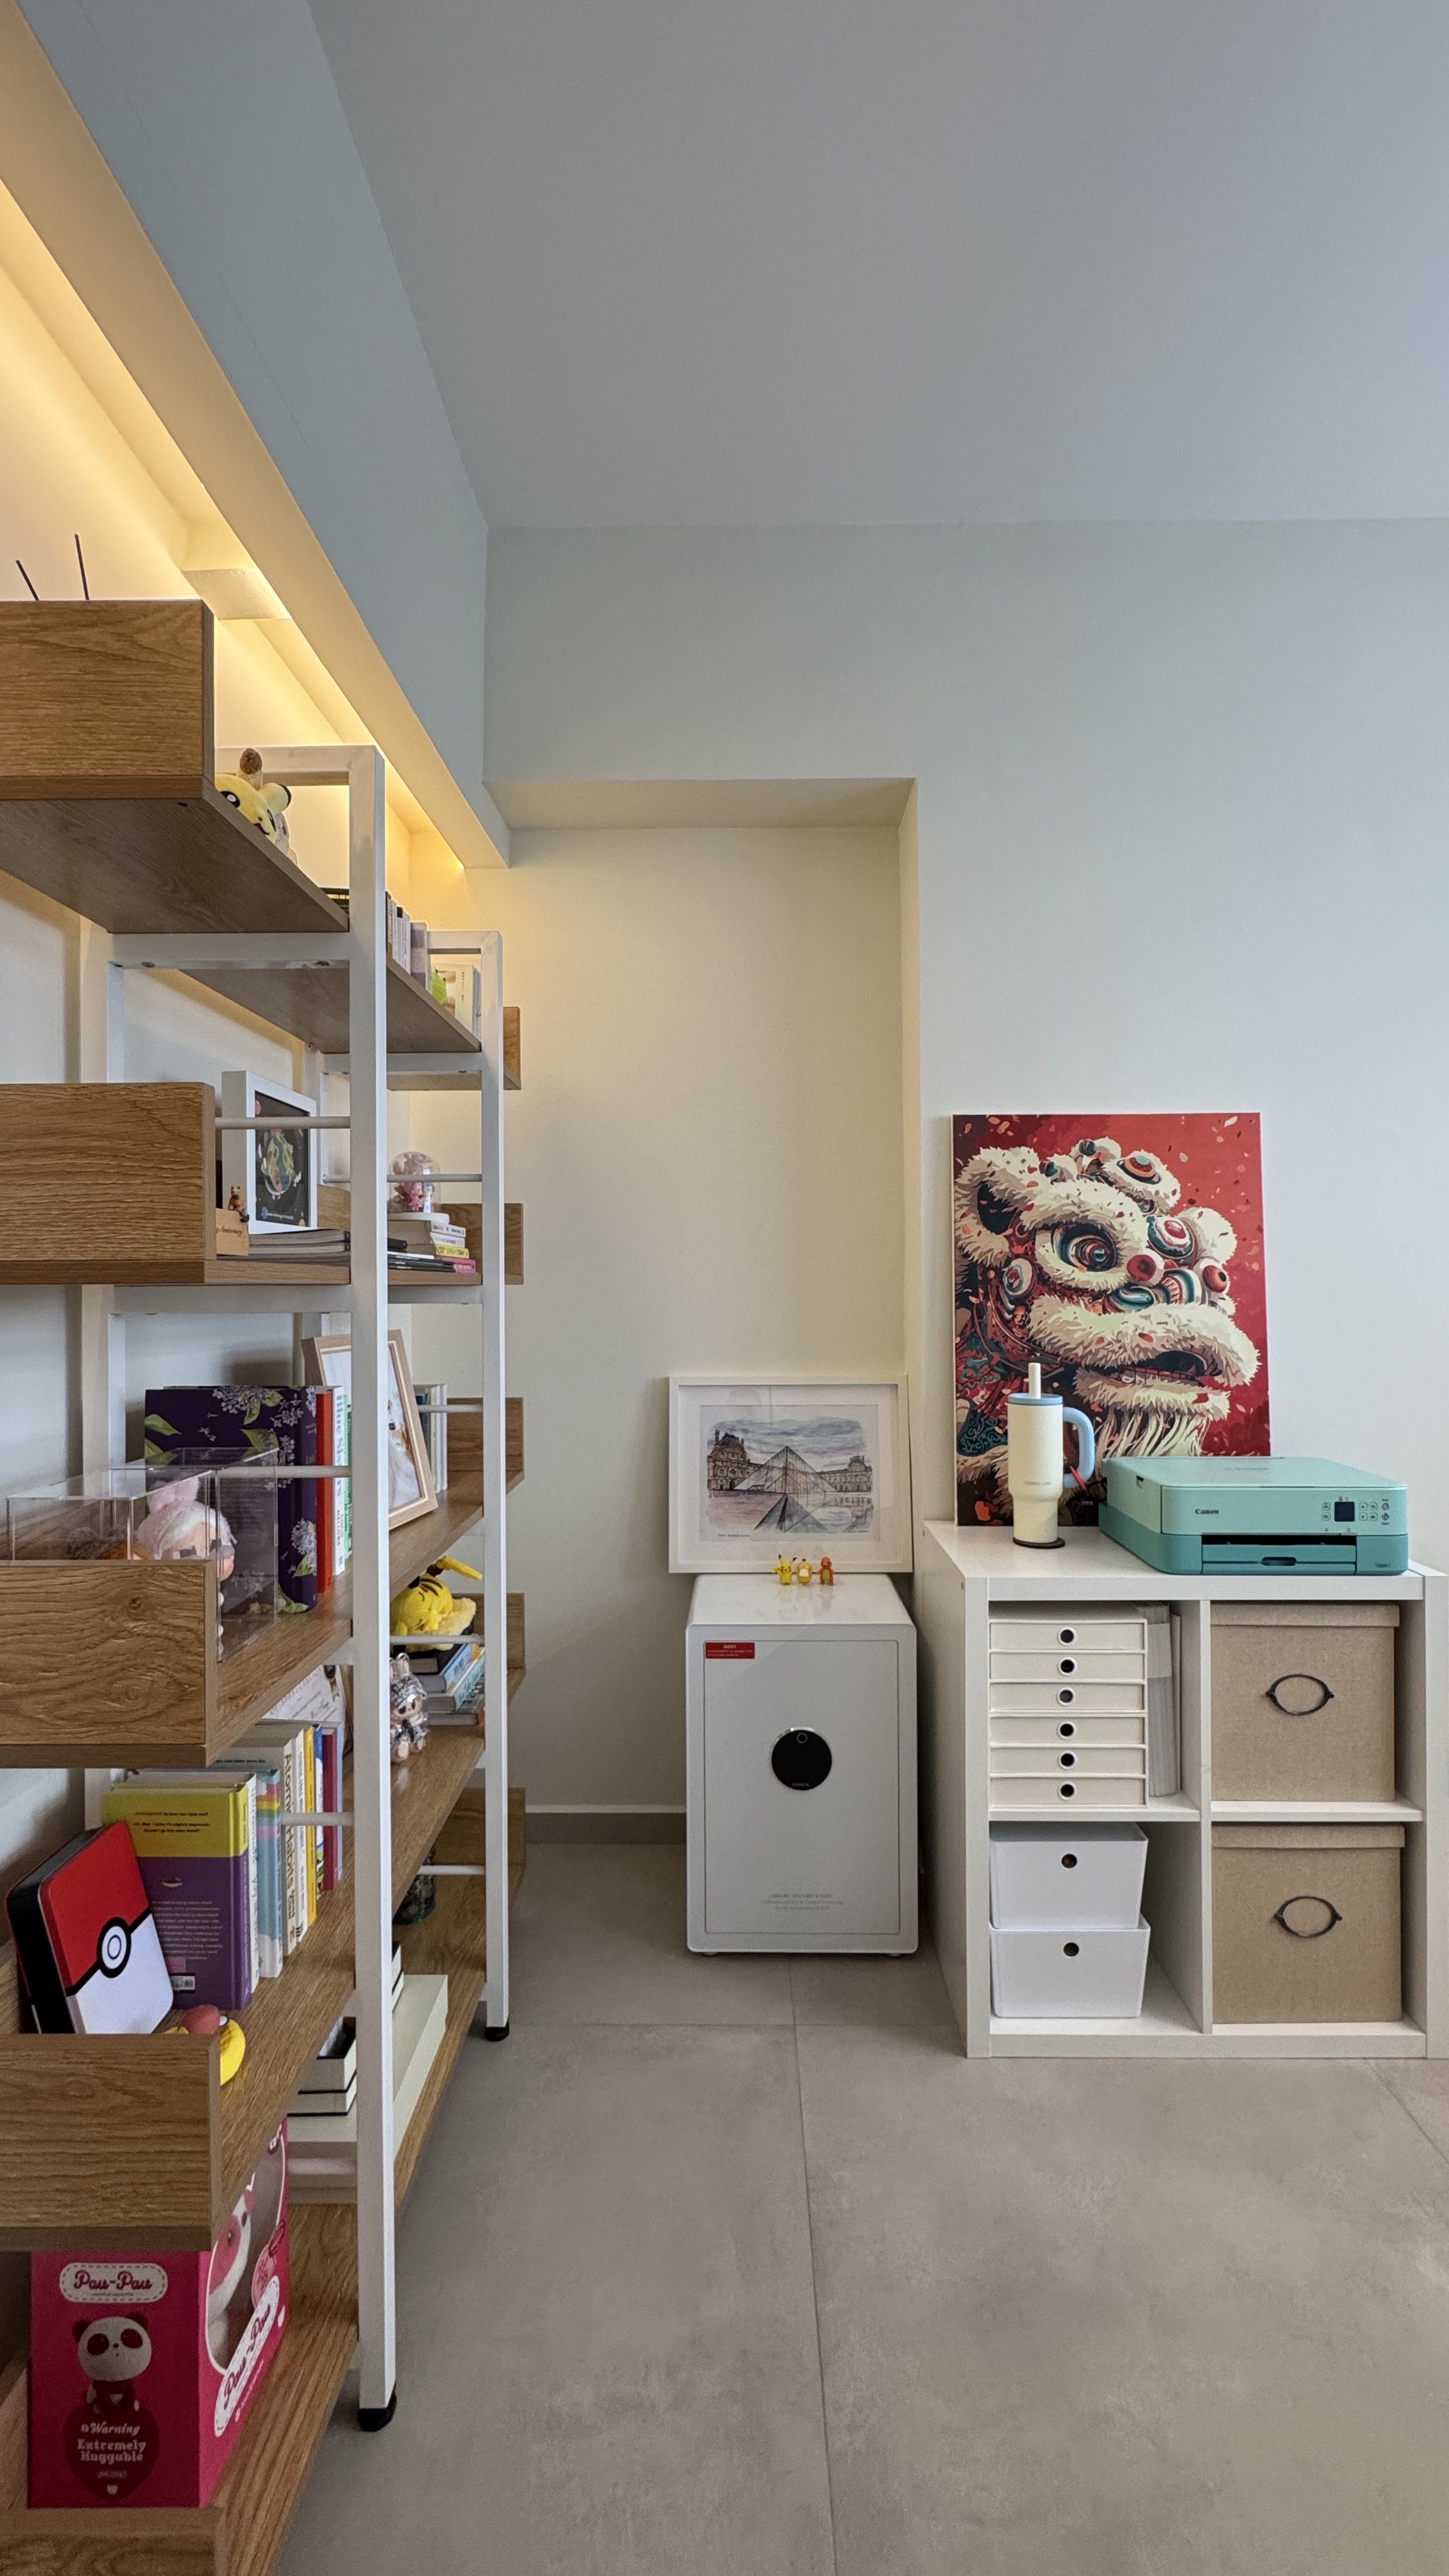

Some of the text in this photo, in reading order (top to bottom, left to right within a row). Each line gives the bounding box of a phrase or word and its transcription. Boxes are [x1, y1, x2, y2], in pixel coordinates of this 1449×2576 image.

[284, 1753, 295, 1889] Atomi Habits
[73, 2269, 153, 2290] Pau-Pau
[224, 2303, 272, 2411] Pau-Pau
[89, 2419, 141, 2437] Warning
[77, 2438, 147, 2453] Extremely
[80, 2450, 144, 2465] Huggable
